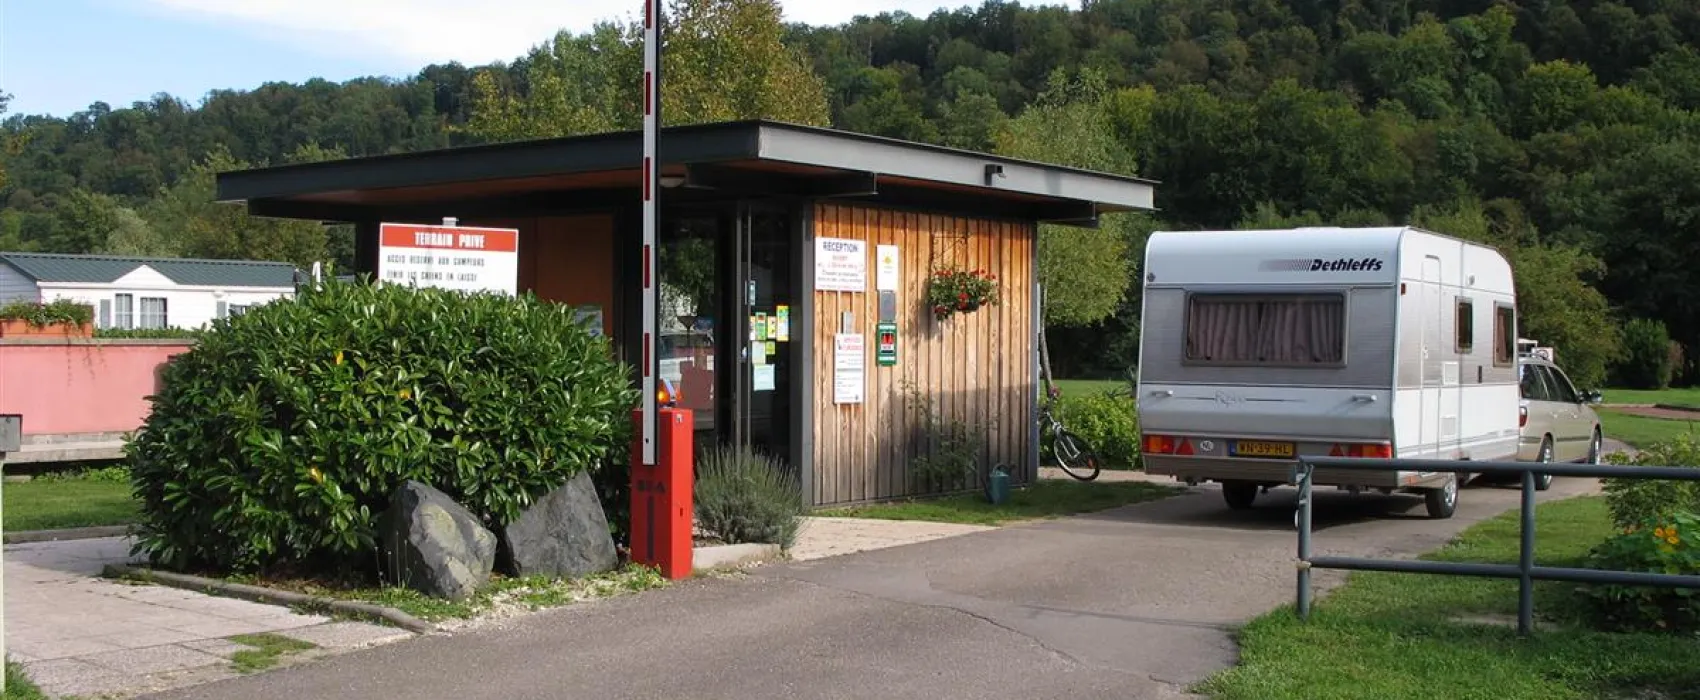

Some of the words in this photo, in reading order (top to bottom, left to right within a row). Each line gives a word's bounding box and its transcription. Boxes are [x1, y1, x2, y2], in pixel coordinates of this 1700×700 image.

[415, 232, 453, 246] TERRAIN
[459, 234, 485, 248] PRIVE
[823, 241, 858, 253] RECEPTION
[1310, 258, 1383, 272] Dethleffs
